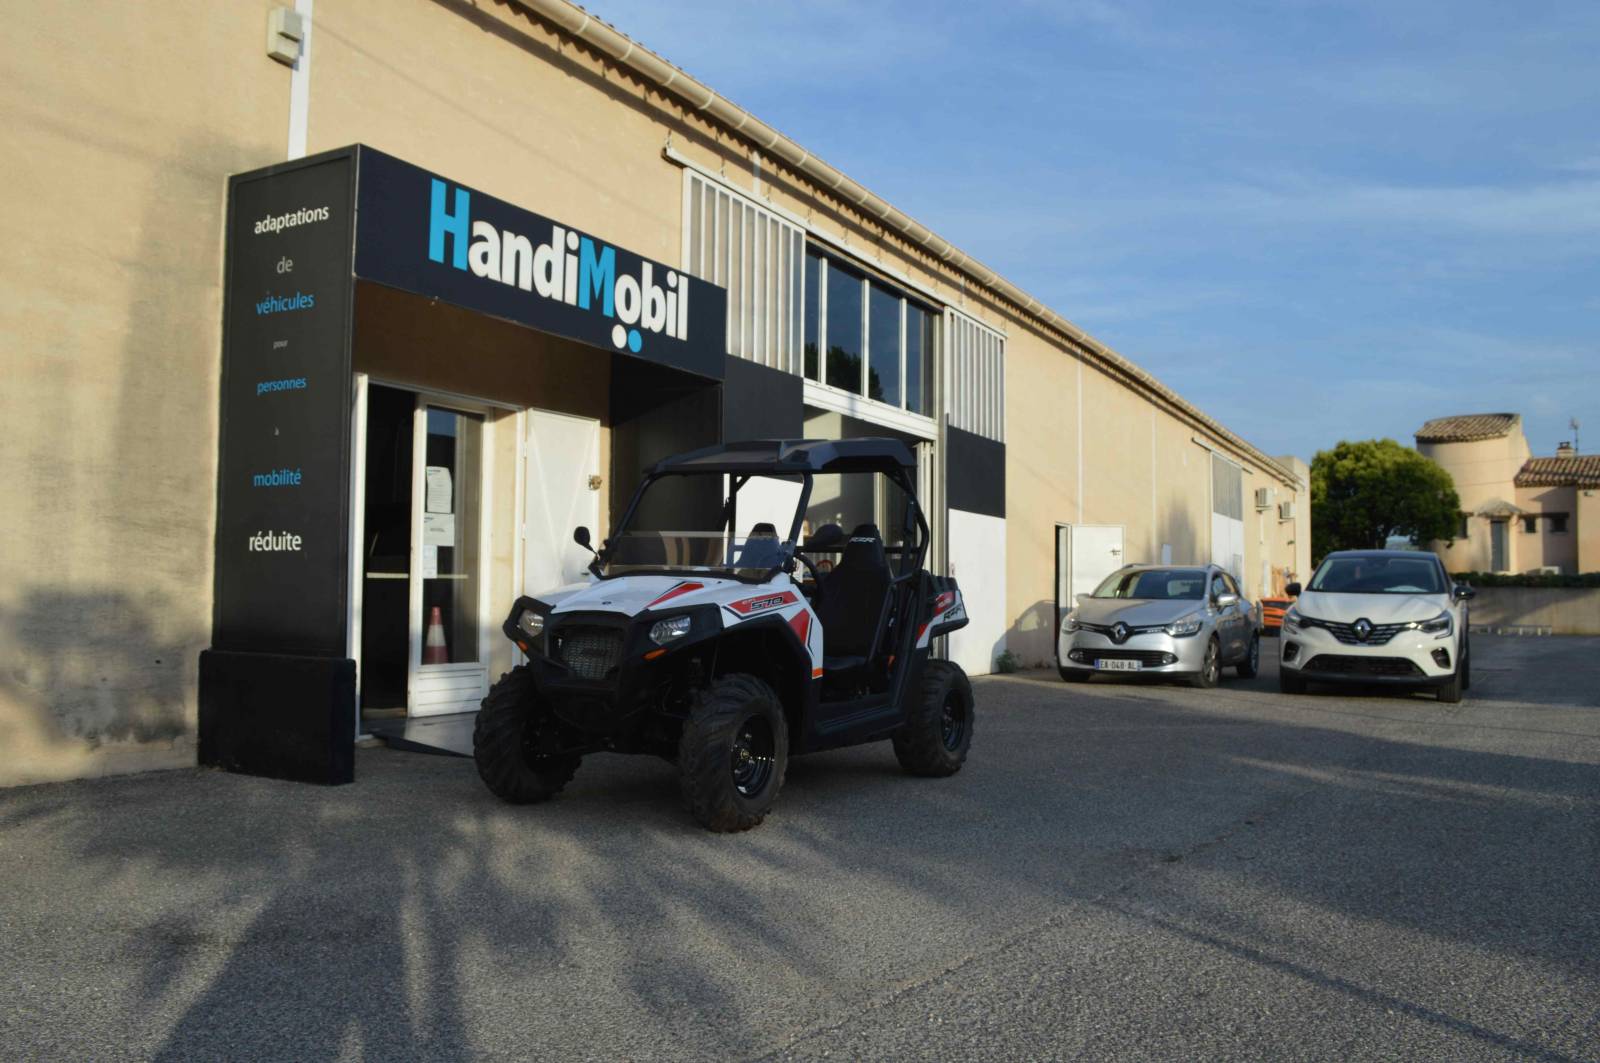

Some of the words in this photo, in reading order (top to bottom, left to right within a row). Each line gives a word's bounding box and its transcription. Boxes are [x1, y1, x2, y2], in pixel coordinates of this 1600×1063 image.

[254, 206, 330, 235] adaptations
[277, 256, 294, 274] de
[428, 177, 689, 342] HandiMobil
[256, 291, 315, 315] véhicules
[257, 378, 307, 396] personnes
[253, 467, 302, 487] mobilité
[248, 530, 302, 551] réduite
